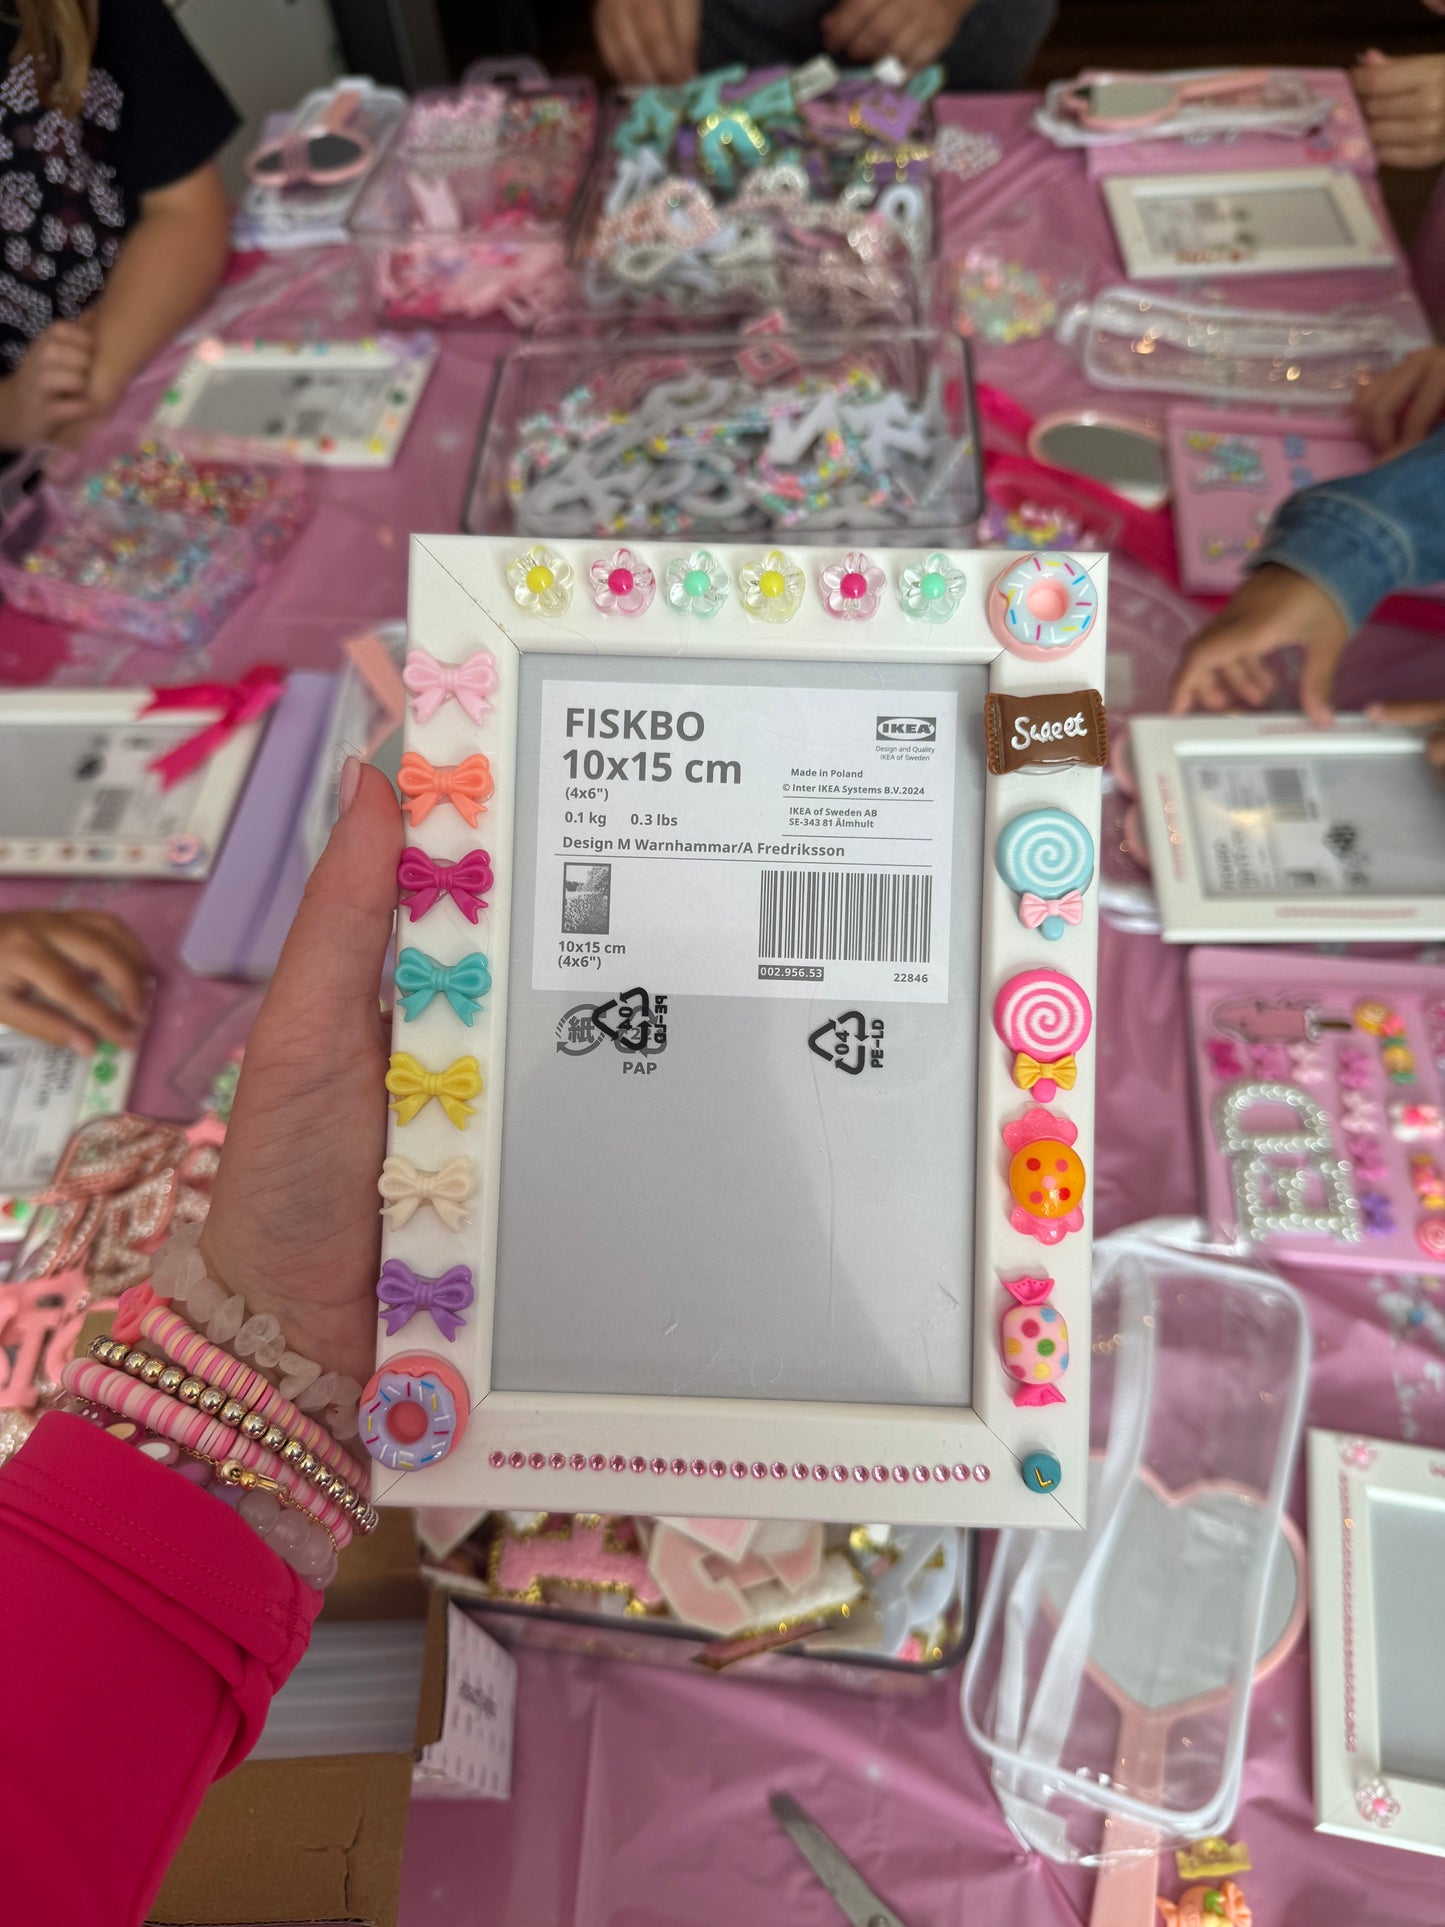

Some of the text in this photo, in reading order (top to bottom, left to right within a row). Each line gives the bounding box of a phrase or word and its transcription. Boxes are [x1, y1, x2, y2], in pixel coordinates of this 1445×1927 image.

[566, 708, 705, 742] FISKBO
[882, 723, 931, 734] IKEA
[1011, 711, 1088, 751] Sweet
[875, 745, 898, 754] Design
[912, 746, 936, 754] Quality
[562, 749, 742, 784] 10x15 cm
[791, 768, 863, 778] Made in Poland
[565, 787, 609, 802] (4x6")
[782, 783, 925, 796] © Inter IKEA Systems B.V.2024
[564, 811, 678, 827] 0.1 kg 0.3 lbs
[789, 807, 878, 817] IKEA of Sweden AB
[789, 817, 874, 828] SE-343 81 Älmhult
[562, 836, 845, 857] Design M Warnhammar/A Fredriksson
[558, 940, 626, 954] 10x15 cm
[557, 955, 602, 970] (4x6")
[760, 966, 929, 983] 002.956.53 22846
[568, 1016, 596, 1043] 紙
[834, 1030, 850, 1055] 04
[870, 1019, 885, 1068] PE-LD
[622, 1061, 658, 1075] PAP
[1033, 1466, 1054, 1488] L
